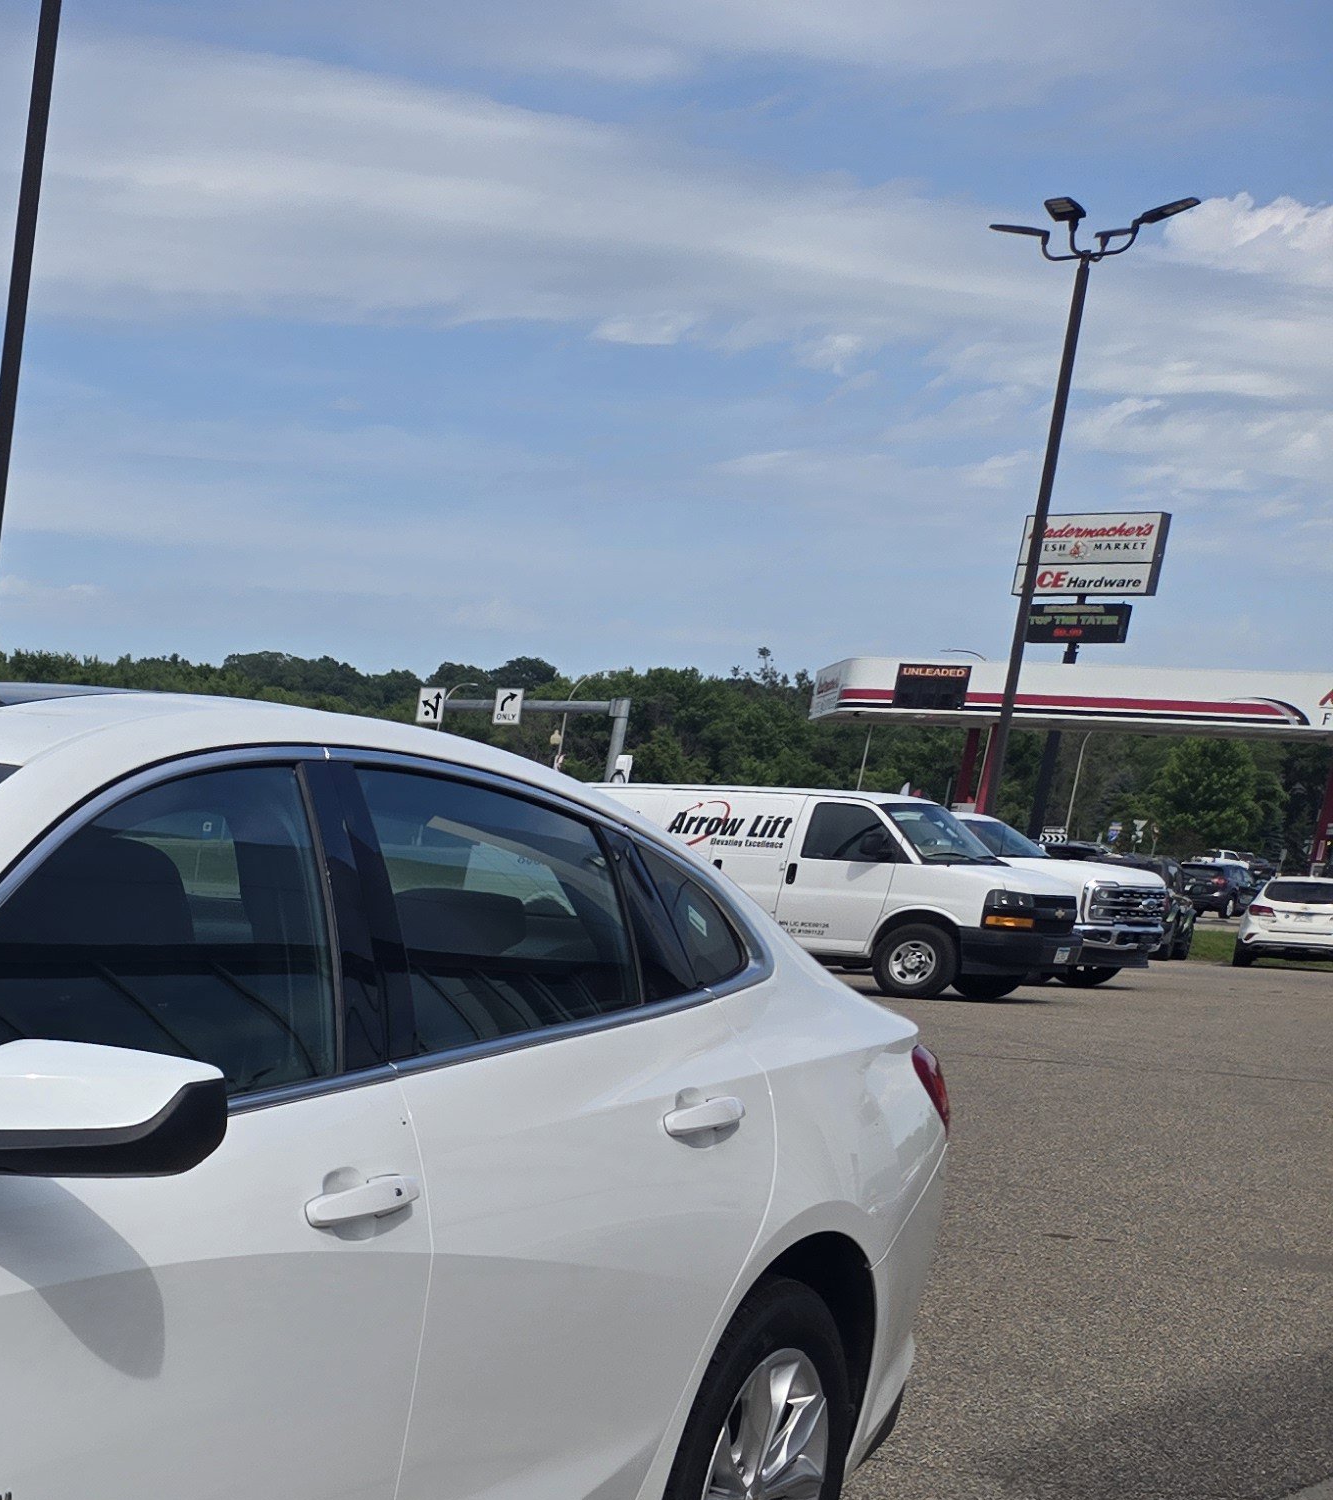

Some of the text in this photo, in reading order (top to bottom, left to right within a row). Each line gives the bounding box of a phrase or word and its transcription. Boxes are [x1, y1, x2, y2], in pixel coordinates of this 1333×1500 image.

[1028, 521, 1154, 540] adermacher's
[1093, 542, 1147, 551] MARKET
[1020, 570, 1142, 589] CE Hardware
[903, 667, 966, 677] UNLEADED
[667, 811, 793, 839] Arrow Lift
[710, 838, 784, 849] Elevating Excellence
